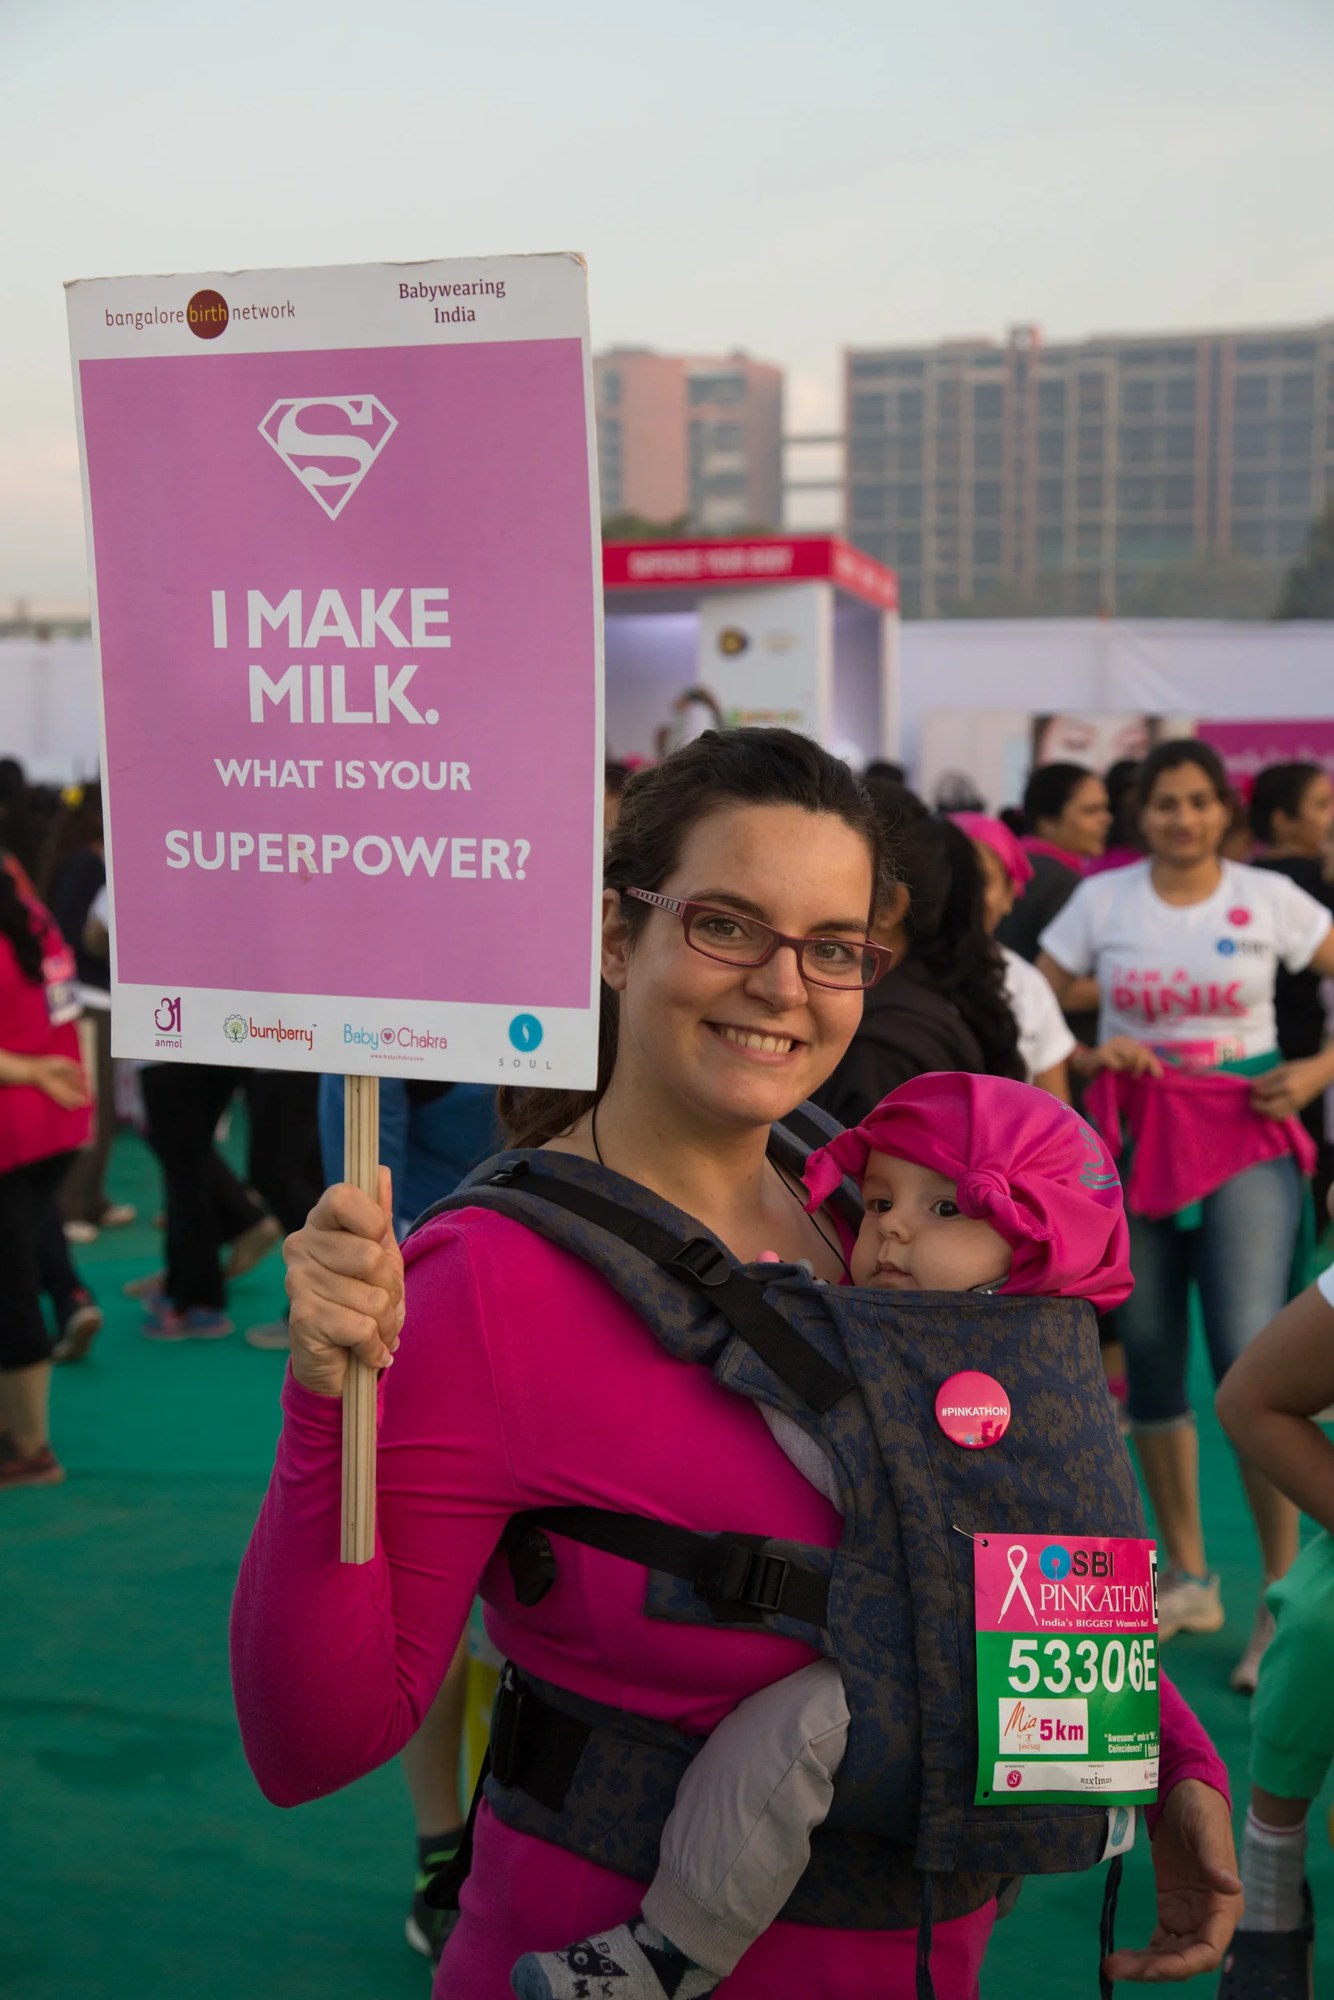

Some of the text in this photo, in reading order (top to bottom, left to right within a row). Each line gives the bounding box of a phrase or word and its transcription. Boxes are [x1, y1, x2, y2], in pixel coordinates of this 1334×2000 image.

[399, 279, 506, 302] Babywearing
[105, 300, 296, 331] bangalore birth network
[434, 306, 476, 324] India
[211, 588, 451, 649] I MAKE
[249, 664, 439, 725] MILK.
[214, 758, 472, 791] WHAT IS YOUR
[165, 829, 531, 880] SUPERPOWER?
[155, 1038, 182, 1048] anmol
[343, 1024, 448, 1050] Baby Chakra
[498, 1058, 552, 1070] SOUL
[941, 1407, 1008, 1417] #PINKATHON
[1072, 1550, 1114, 1577] SBI
[1040, 1583, 1149, 1612] PINKATHON
[1041, 1618, 1073, 1627] India's
[1076, 1619, 1113, 1627] BIGGEST
[1008, 1638, 1157, 1693] 53306E
